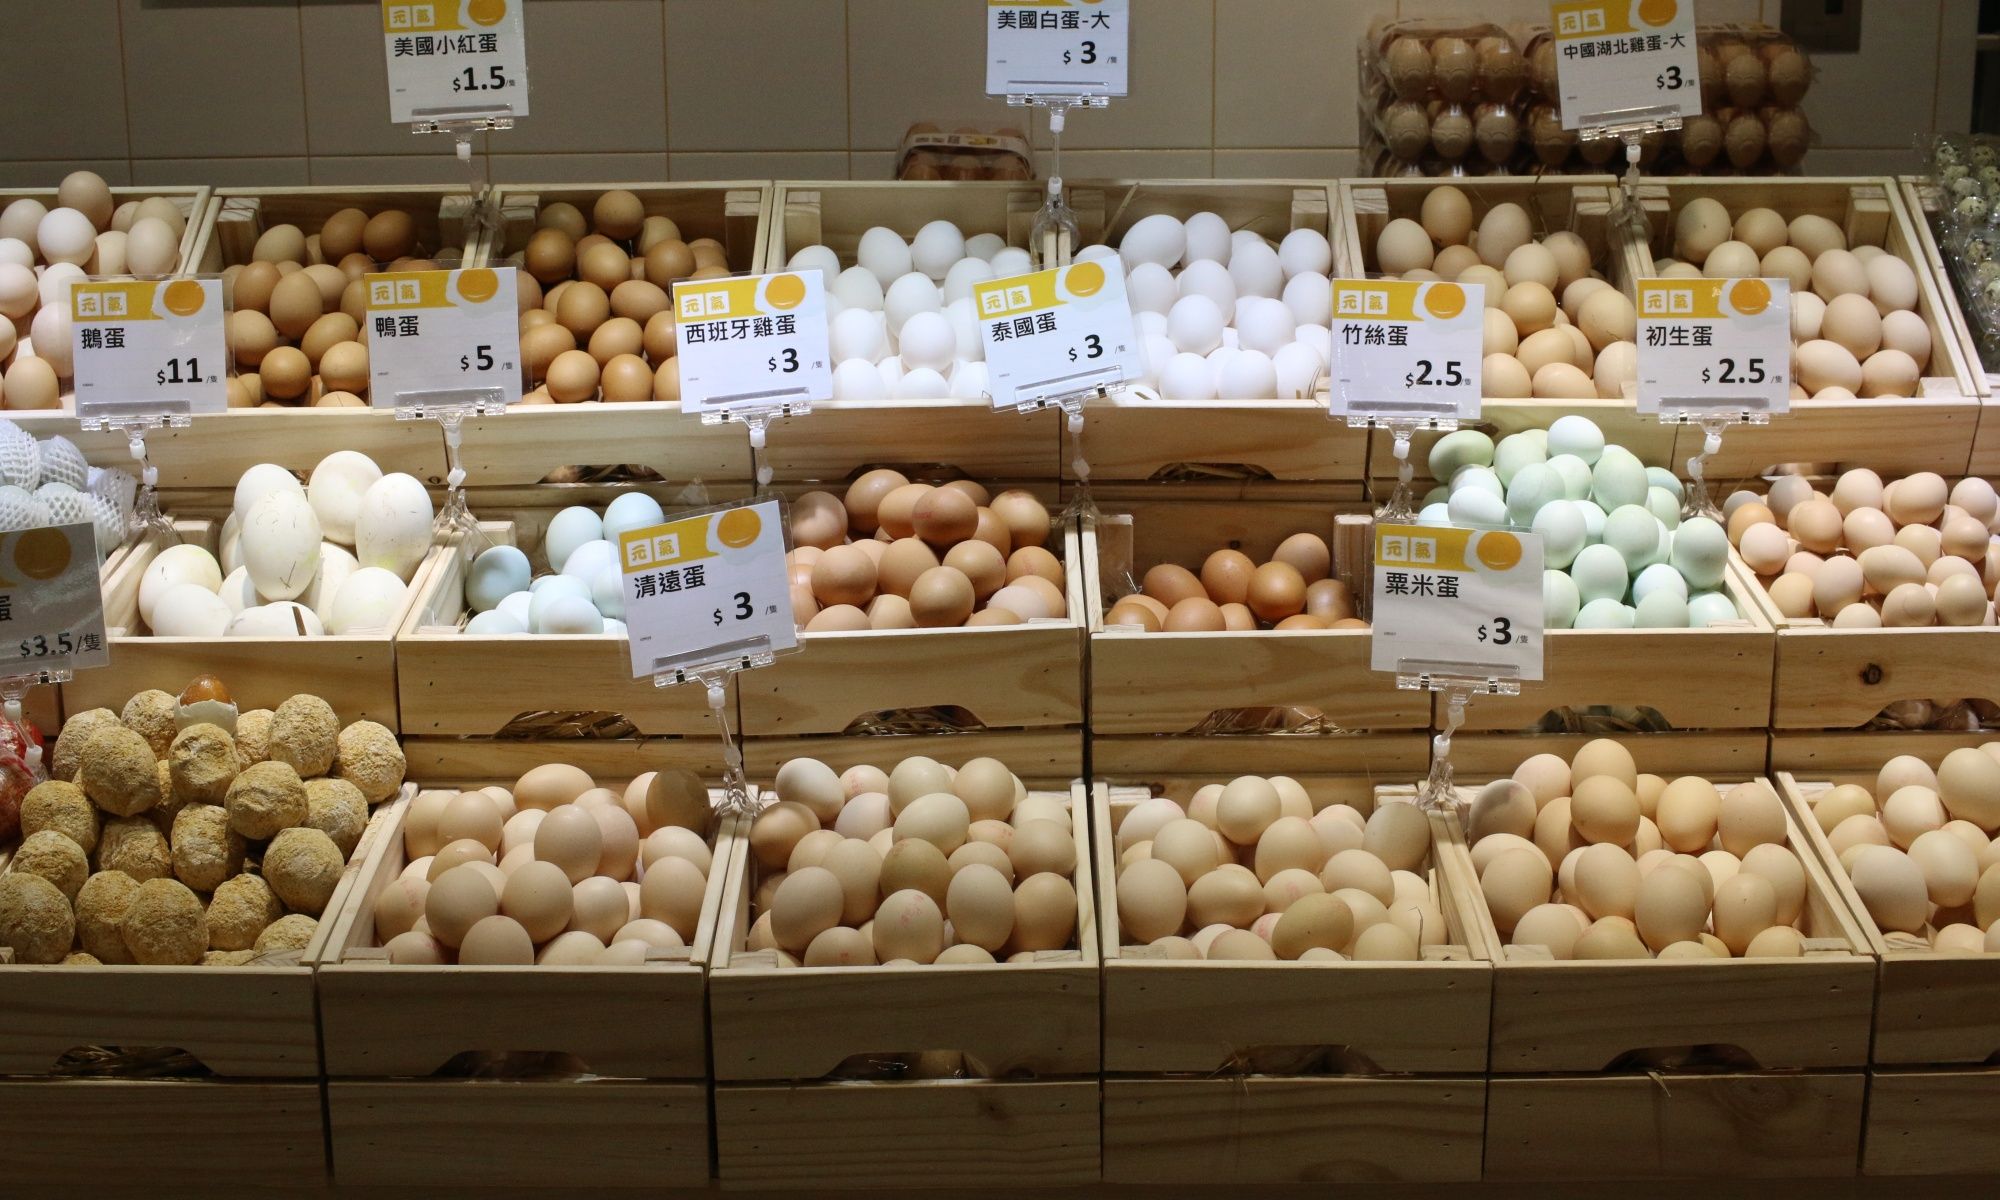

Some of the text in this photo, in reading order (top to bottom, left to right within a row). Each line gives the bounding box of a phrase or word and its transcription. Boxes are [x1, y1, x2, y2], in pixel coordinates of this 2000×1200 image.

[997, 10, 1110, 30] 美國白蛋-大
[394, 33, 498, 57] 美國小紅蛋
[1563, 33, 1686, 60] 中國湖北雞蛋-大
[81, 327, 125, 349] 鵝蛋
[375, 315, 420, 338] 鴨蛋
[685, 314, 797, 344] 西班牙雞蛋
[991, 311, 1058, 342] 泰國蛋
[1342, 323, 1409, 346] 竹絲蛋
[1645, 325, 1713, 347] 初生蛋
[633, 564, 706, 599] 清遠蛋
[1384, 571, 1459, 599] 粟米蛋
